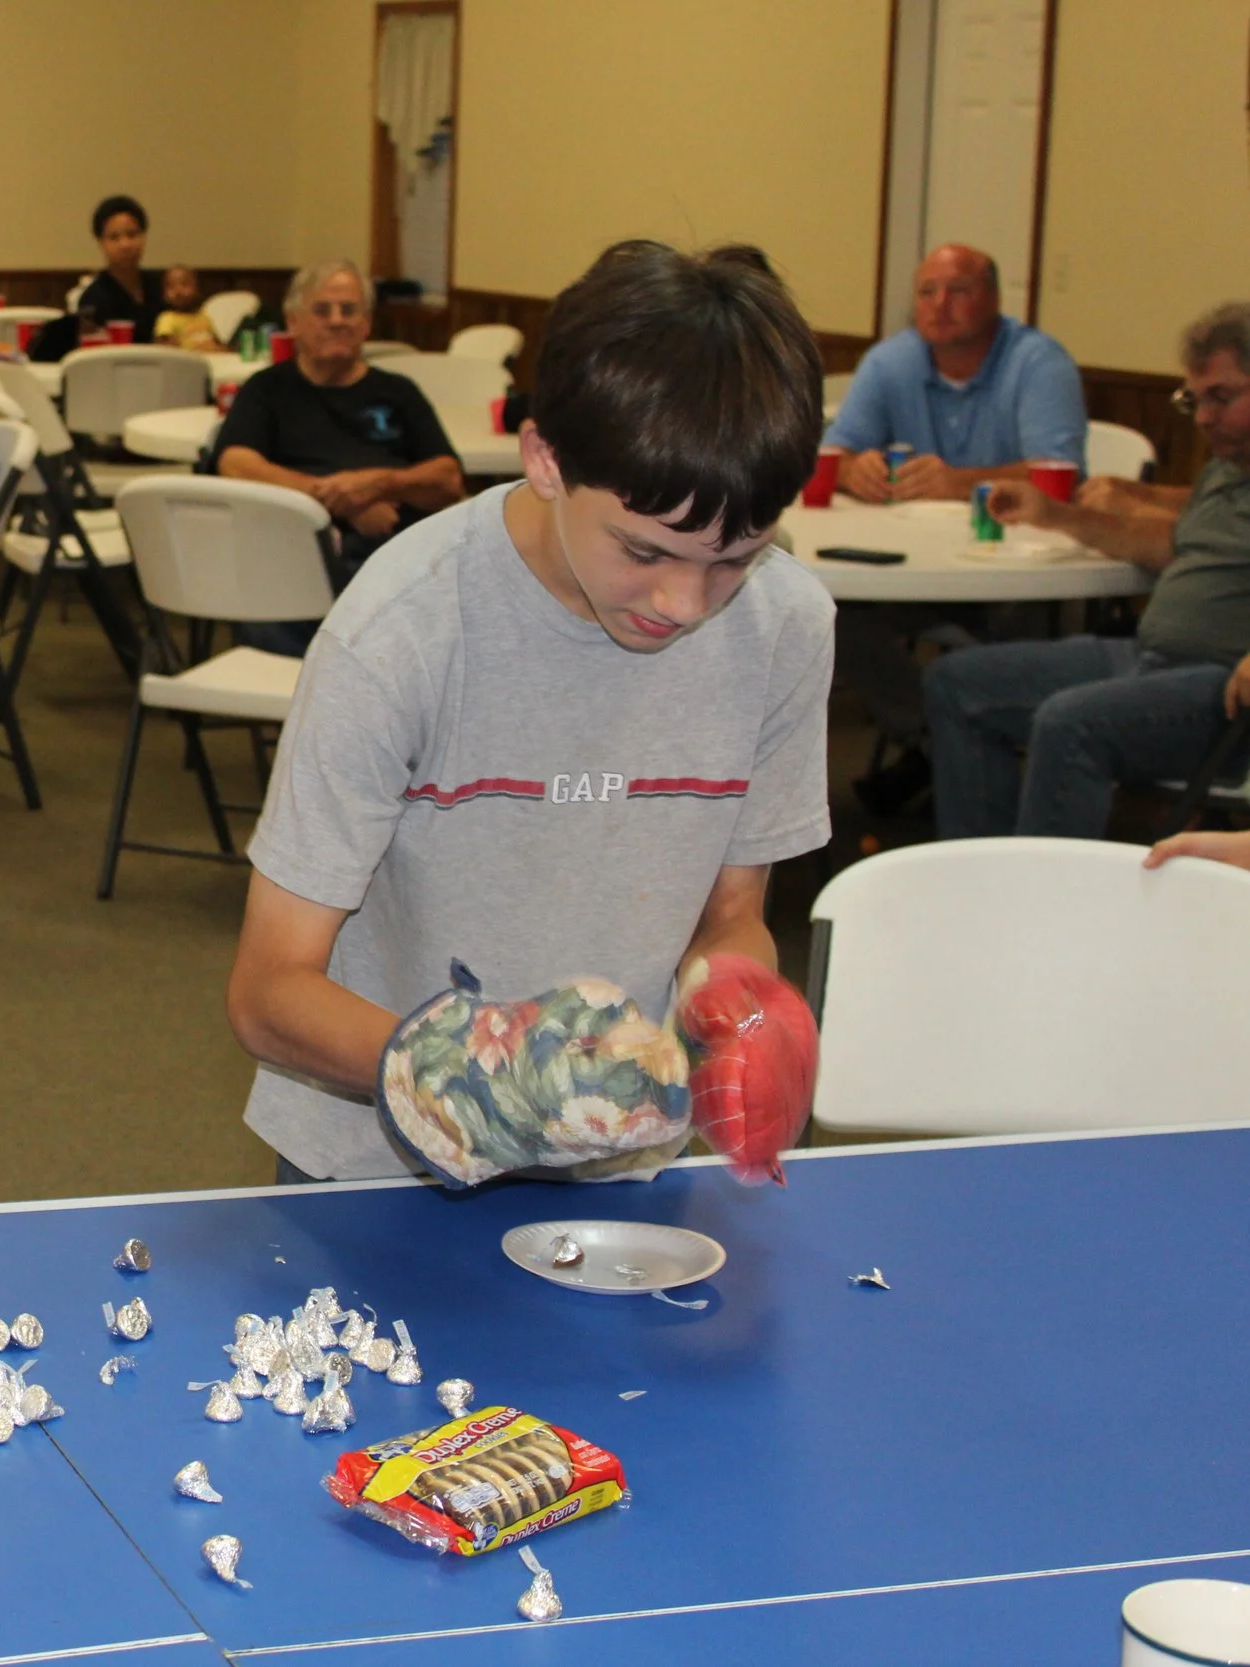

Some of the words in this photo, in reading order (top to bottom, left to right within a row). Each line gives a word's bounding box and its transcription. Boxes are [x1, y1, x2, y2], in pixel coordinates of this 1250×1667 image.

[550, 771, 625, 805] GAP
[413, 1433, 478, 1463] Duplex
[469, 1407, 522, 1435] Creme
[543, 1500, 579, 1527] Creme
